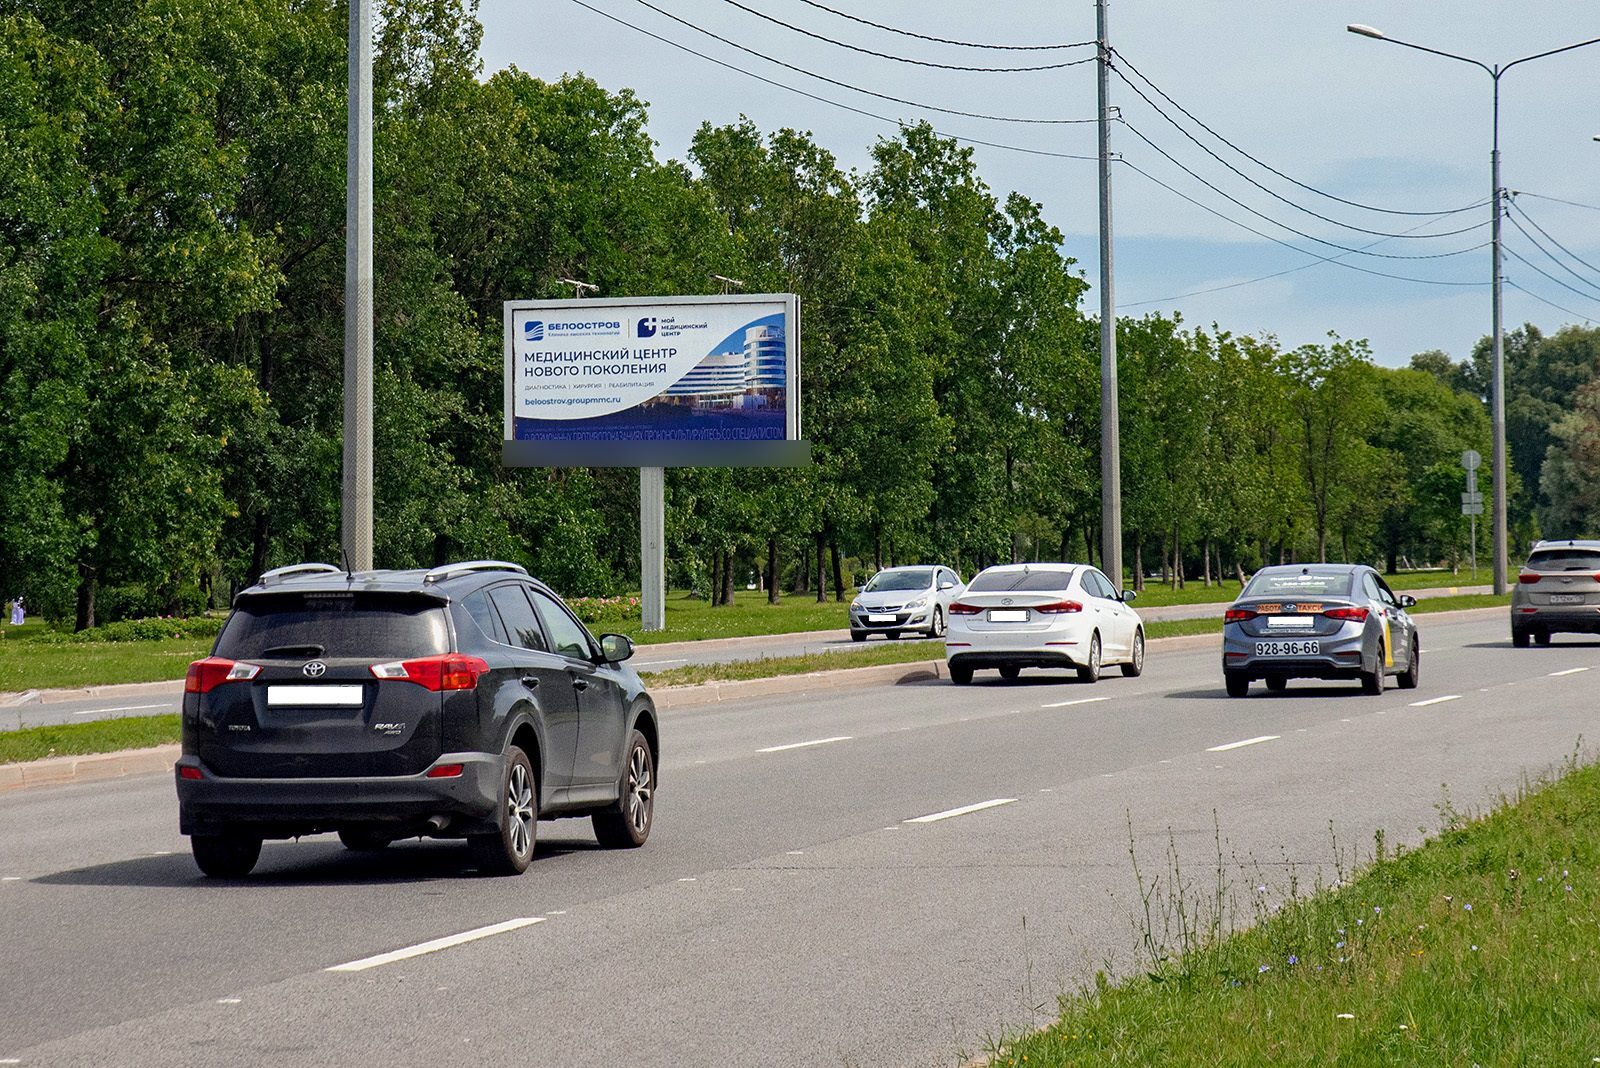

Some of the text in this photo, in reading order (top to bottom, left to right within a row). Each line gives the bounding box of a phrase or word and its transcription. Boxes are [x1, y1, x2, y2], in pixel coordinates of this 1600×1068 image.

[548, 321, 620, 330] БЕЛООСТРОВ
[661, 322, 708, 331] МЕДИЦИНСКИЙ
[524, 348, 677, 364] МЕДИЦИНСКИЙ ЦЕНТР
[524, 363, 667, 377] НОВОГО ПОКОЛЕНИЯ
[608, 381, 655, 389] РЕАБИЛИТАЦИЯ
[525, 397, 621, 406] beloostrov.groupmmc.ru
[1257, 604, 1281, 612] РАБОТА
[1298, 603, 1323, 611] ТАКСИ
[1256, 641, 1319, 656] 928-96-66
